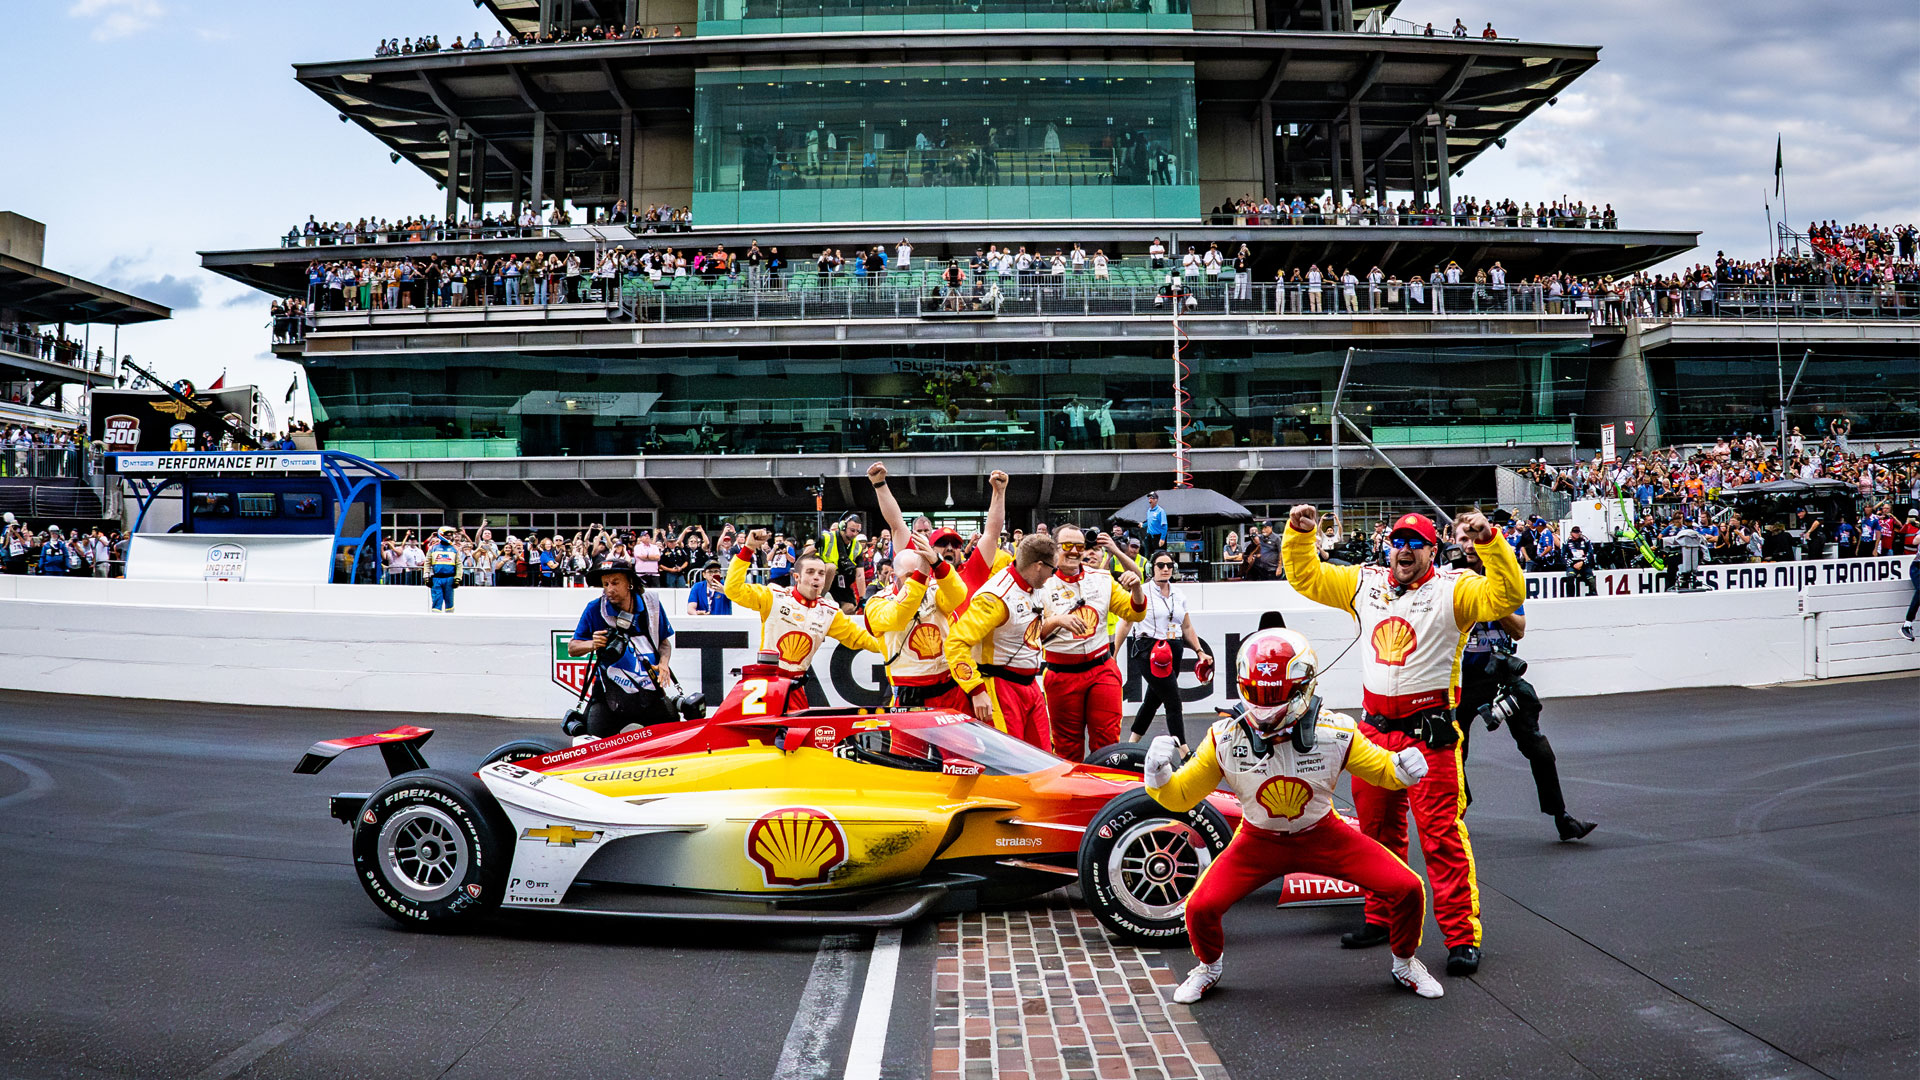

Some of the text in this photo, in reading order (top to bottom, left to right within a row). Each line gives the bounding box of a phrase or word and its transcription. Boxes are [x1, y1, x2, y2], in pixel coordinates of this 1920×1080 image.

[112, 421, 132, 429] INDY
[104, 429, 139, 445] 500
[157, 457, 277, 470] PERFORMANCE PIT
[1642, 507, 1652, 516] 42
[223, 552, 240, 560] NTT
[1604, 574, 1631, 596] 14
[1726, 567, 1768, 589] FOR
[1822, 560, 1902, 585] TROOPS
[741, 679, 768, 715] 2
[541, 729, 653, 765] Clarience TECHNOLOGIES
[583, 766, 679, 782] Gallagher
[942, 764, 980, 775] Mazak
[384, 788, 467, 816] FIREHAWK
[995, 838, 1043, 847] stratasys
[366, 870, 430, 921] Firestone
[509, 895, 556, 904] Firestone
